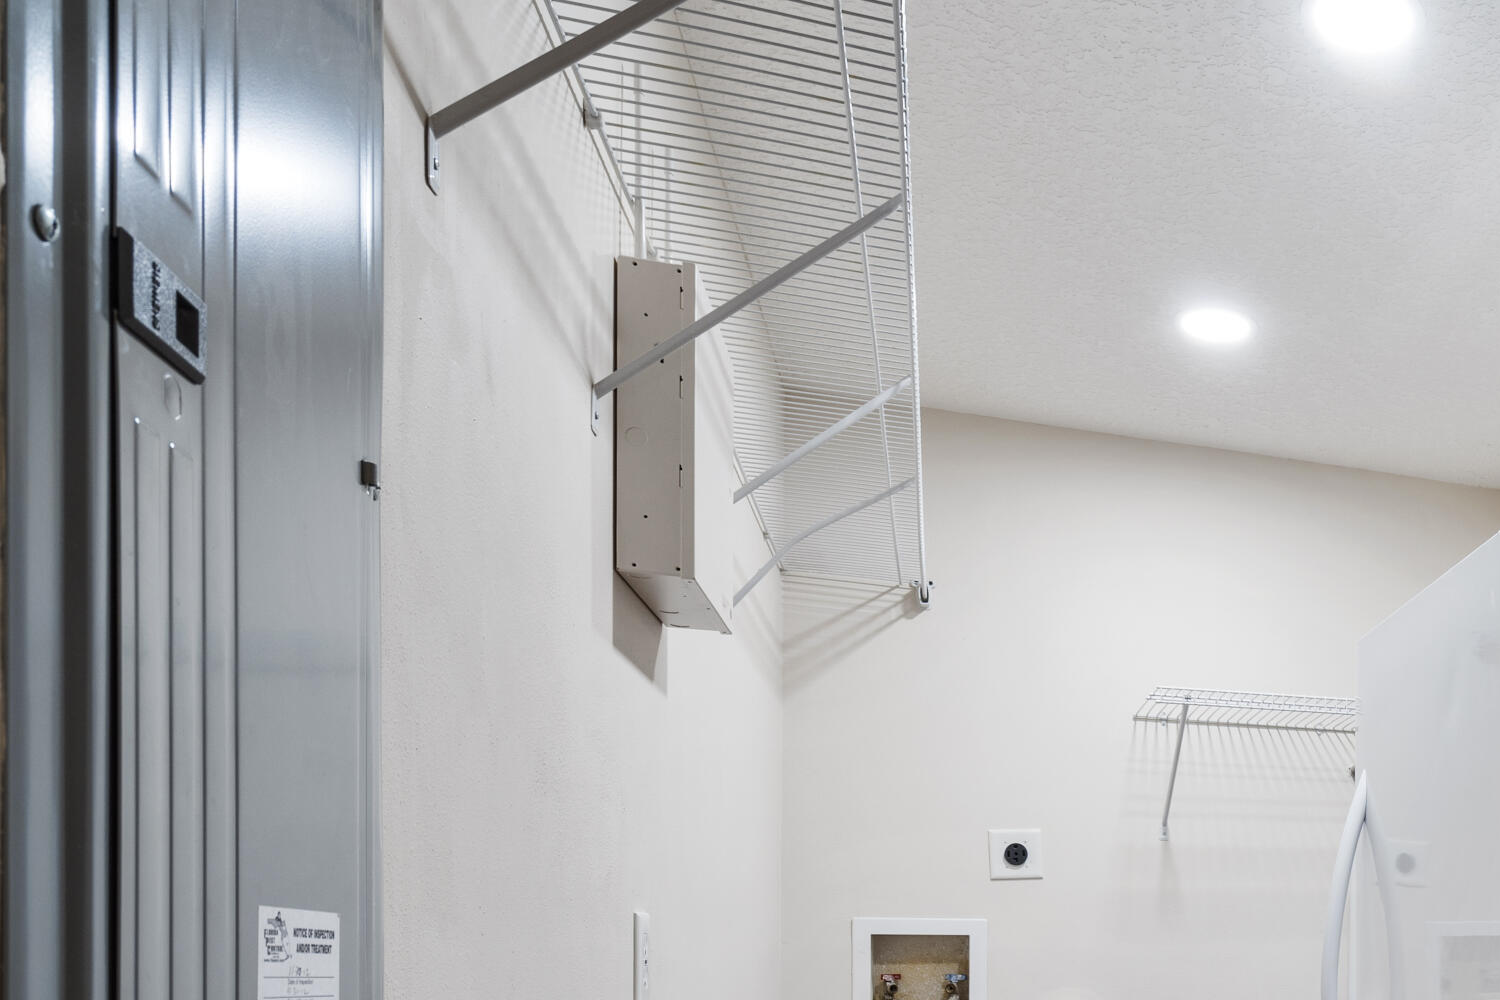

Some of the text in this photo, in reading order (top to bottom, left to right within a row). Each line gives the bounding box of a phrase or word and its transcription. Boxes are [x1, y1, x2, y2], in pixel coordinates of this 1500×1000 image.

[292, 927, 334, 939] NOTICE OF INSPECTION
